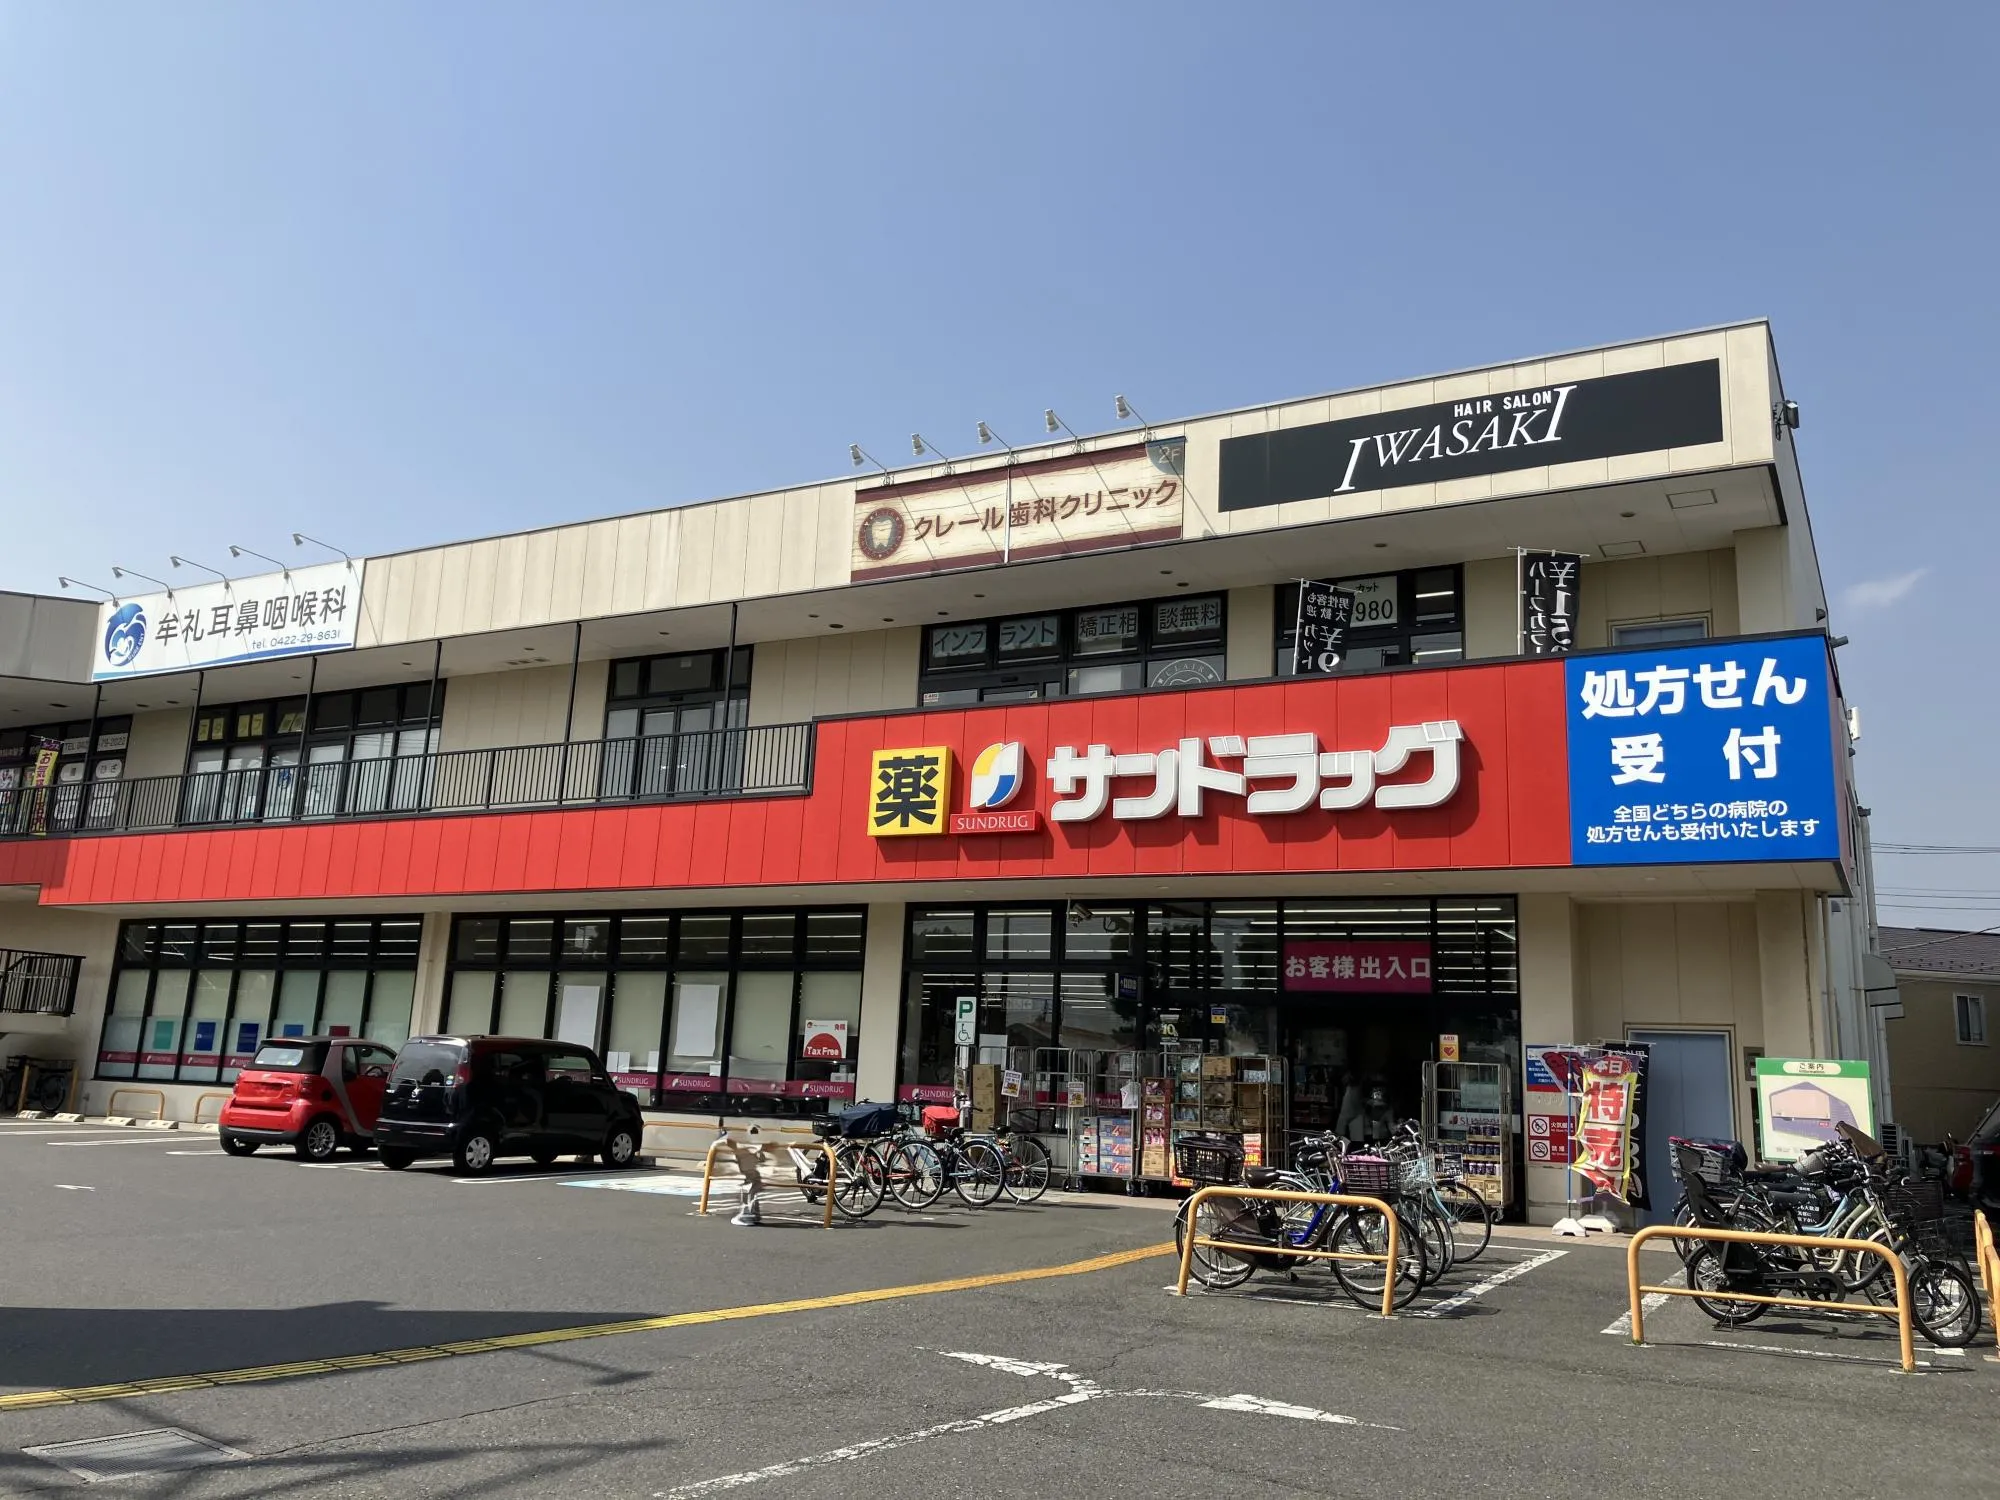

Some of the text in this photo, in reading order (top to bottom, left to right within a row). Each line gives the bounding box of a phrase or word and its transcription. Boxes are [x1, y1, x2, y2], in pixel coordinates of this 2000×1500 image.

[1453, 390, 1552, 418] HAIR SALON
[1333, 384, 1577, 493] IWASAKI
[1158, 446, 1181, 465] 2F
[913, 480, 1178, 541] クレール歯科クリニック
[1356, 582, 1379, 593] カット
[155, 584, 347, 647] 牟礼耳鼻咽喉科
[1355, 598, 1394, 622] 980
[252, 630, 341, 650] tel. 0422-29-8631
[1580, 657, 1808, 720] 処方せん
[1045, 719, 1466, 824] サンドラッグ
[874, 754, 939, 829] 薬
[1613, 799, 1788, 824] 全国どちらの病院の
[956, 814, 1029, 832] SUNDRUG
[1586, 818, 1820, 844] 処方せんも受付いたします
[1285, 955, 1431, 980] お客様出入口
[959, 1001, 974, 1019] P
[806, 1046, 839, 1056] Tax Free
[1593, 1060, 1623, 1074] 本日
[1799, 1062, 1824, 1071] ご案内
[618, 1075, 649, 1085] SUNDRUG
[678, 1078, 711, 1088] SUNDRUG
[809, 1084, 844, 1094] SUNDRUG
[919, 1088, 955, 1098] SUNDRU
